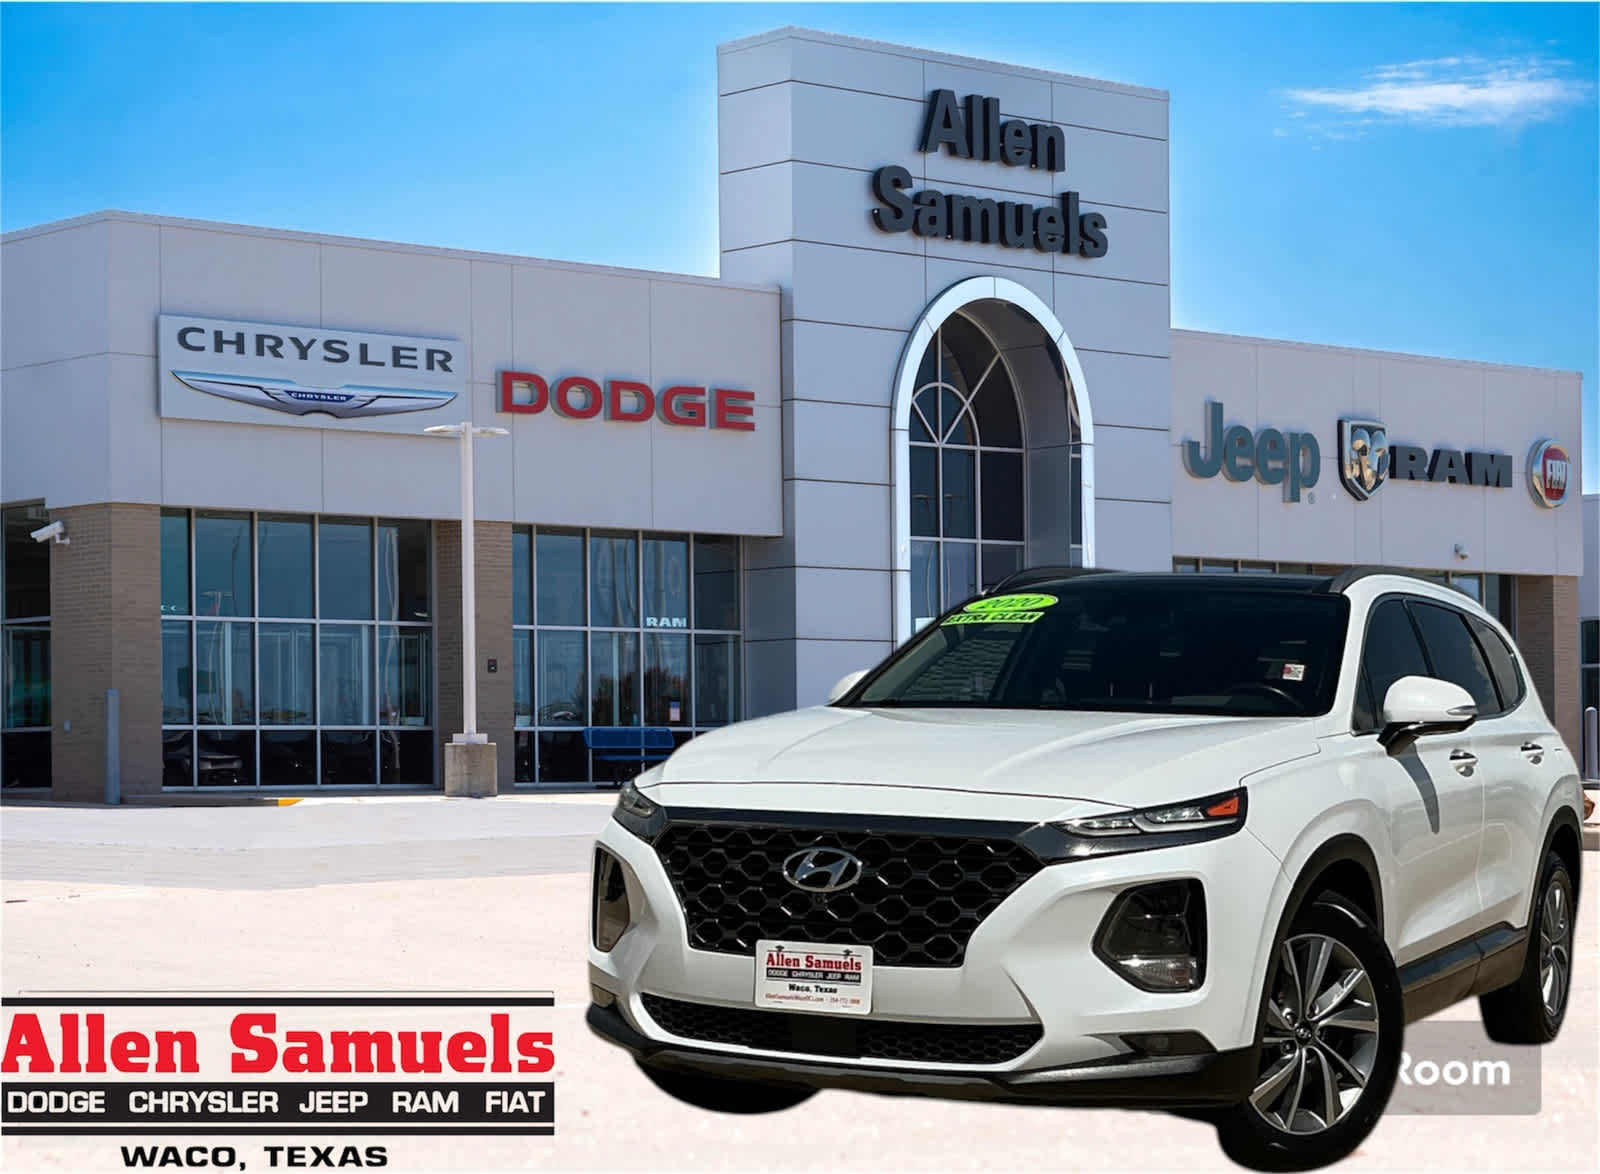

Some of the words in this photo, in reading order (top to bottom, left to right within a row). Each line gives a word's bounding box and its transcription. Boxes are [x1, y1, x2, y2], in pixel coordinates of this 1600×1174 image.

[918, 88, 1066, 172] Allen
[872, 165, 1108, 258] Samuels
[176, 326, 453, 373] CHRYSLER
[290, 391, 347, 401] CHRYSLER
[496, 369, 756, 432] DODGE
[1182, 401, 1321, 503] Jeep
[1388, 445, 1513, 488] RAM
[973, 597, 1046, 611] 2020
[645, 616, 688, 628] RAM
[945, 613, 990, 624] EXTRA
[996, 611, 1039, 621] CLEAN
[766, 952, 801, 968] Allen
[804, 955, 862, 971] Samuels
[792, 970, 824, 980] CHRYSLER
[826, 972, 842, 980] JEEP
[814, 985, 838, 994] Texas
